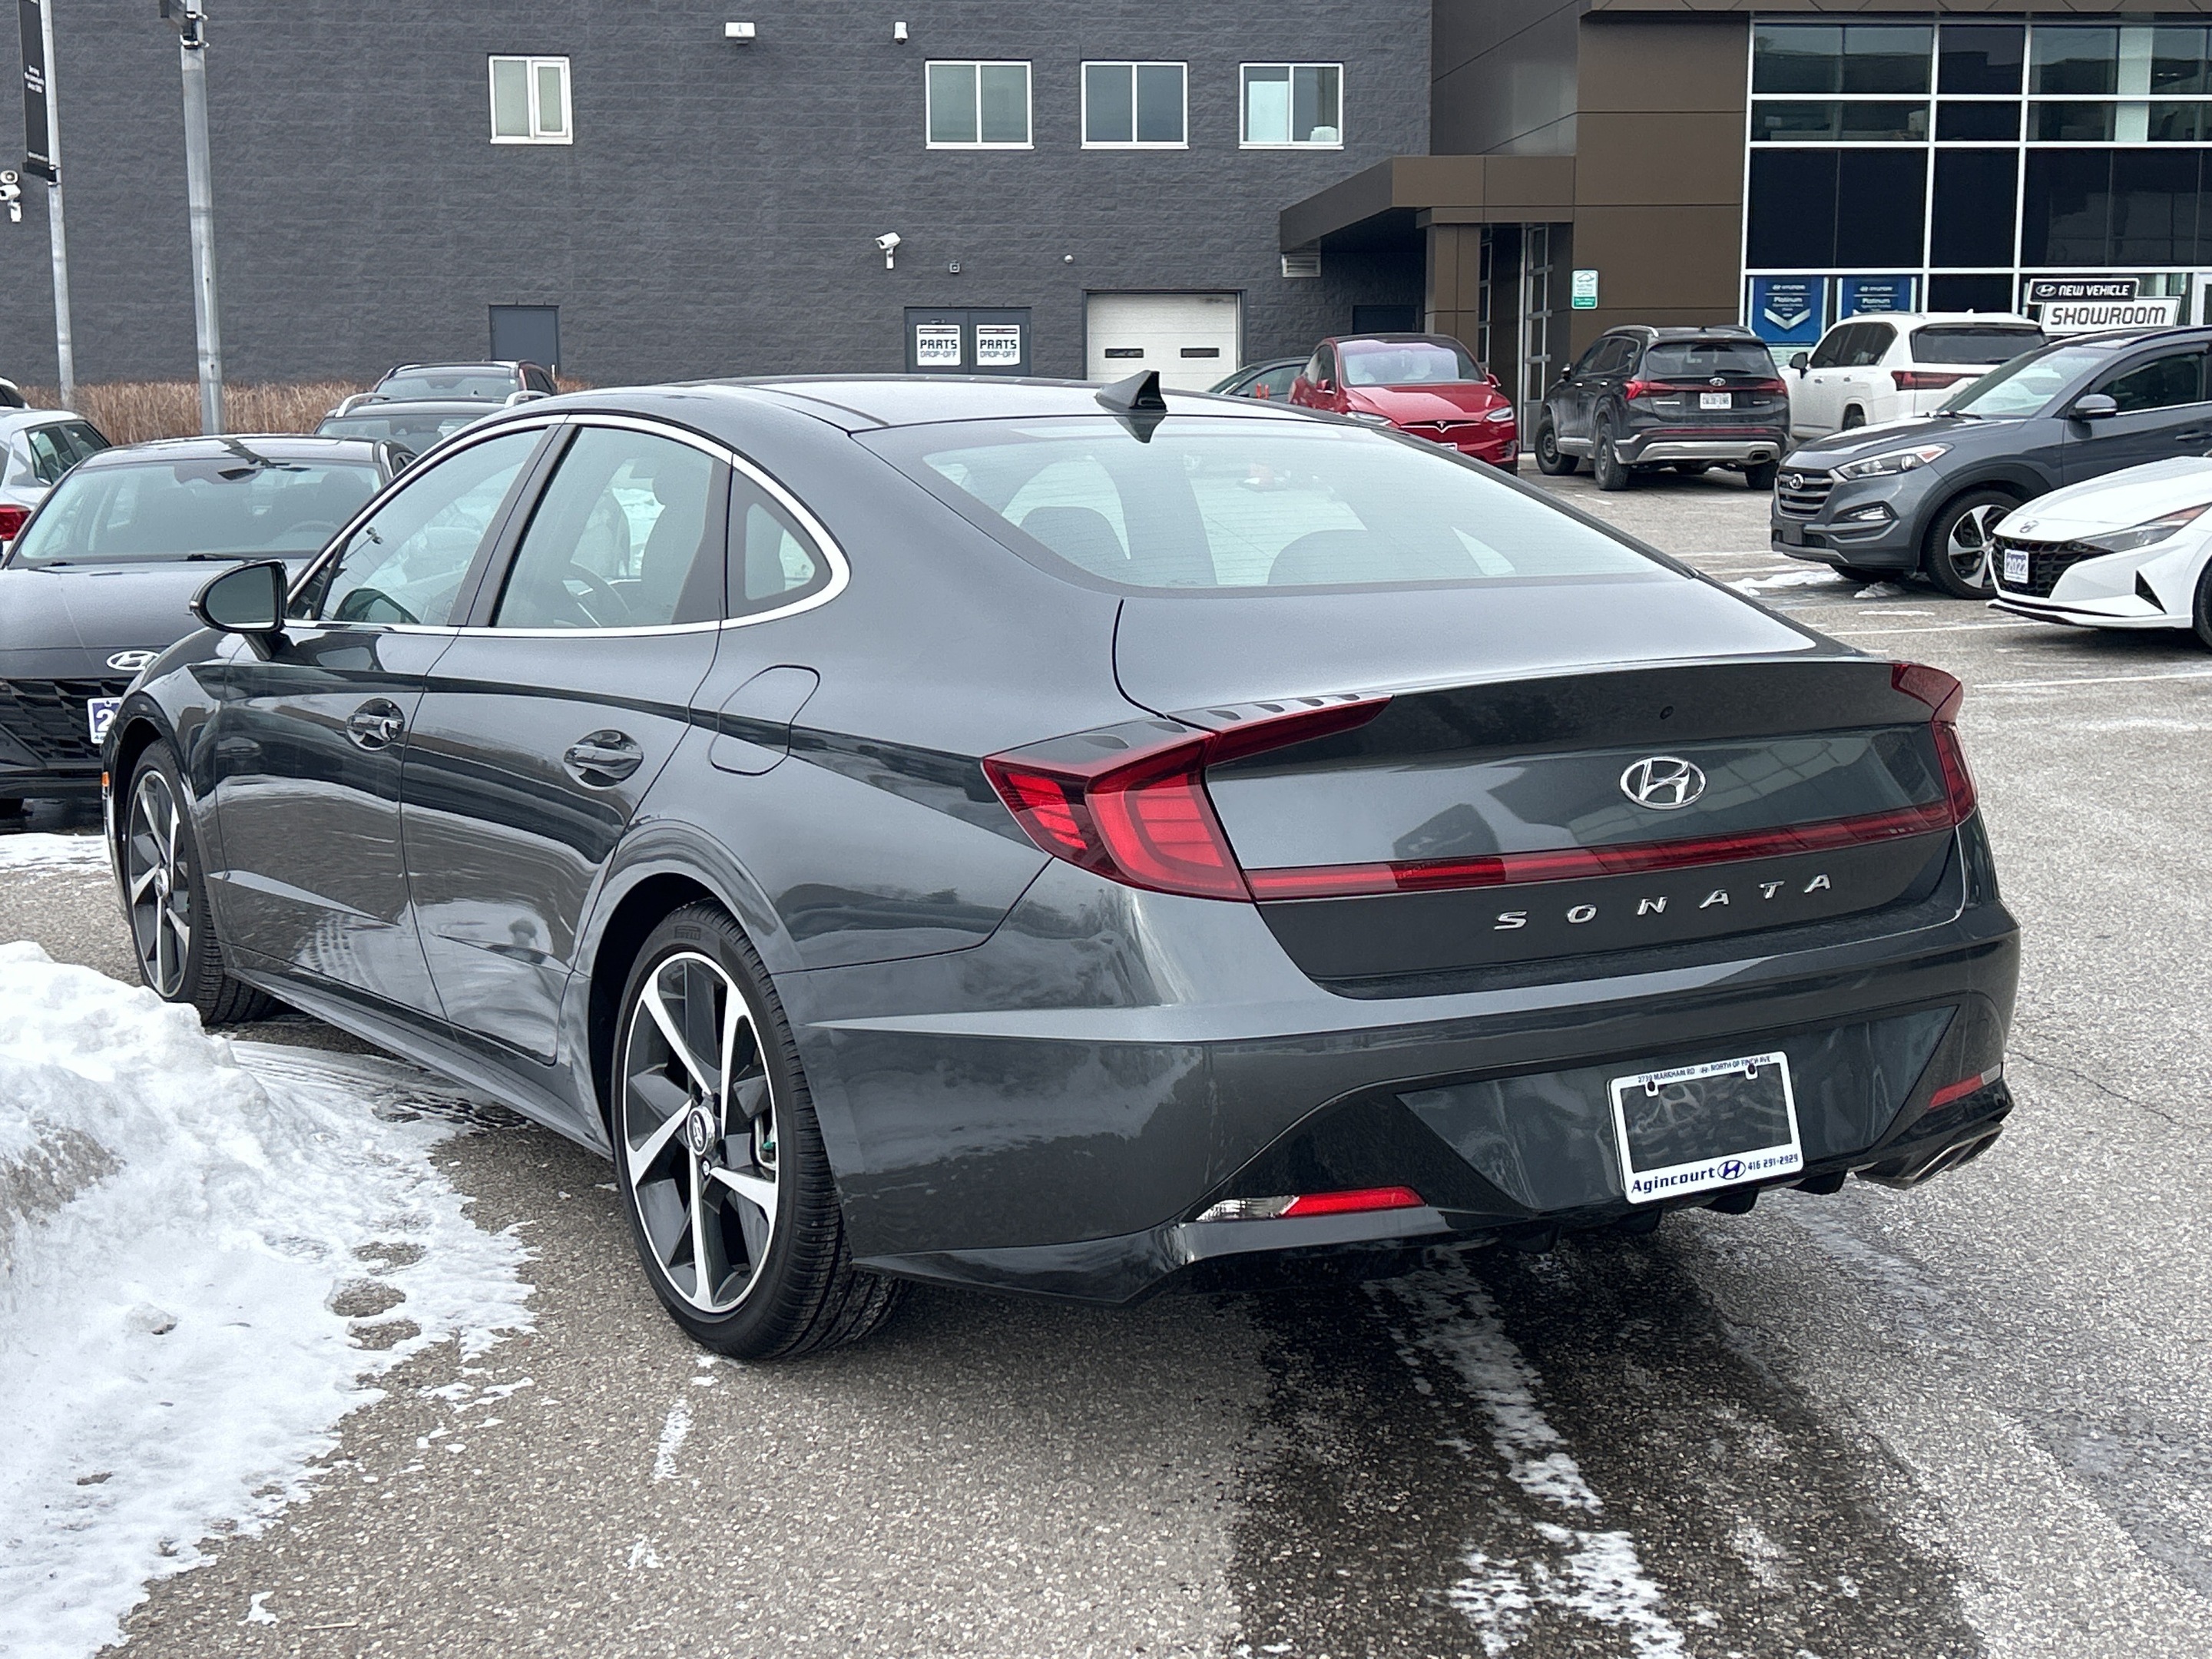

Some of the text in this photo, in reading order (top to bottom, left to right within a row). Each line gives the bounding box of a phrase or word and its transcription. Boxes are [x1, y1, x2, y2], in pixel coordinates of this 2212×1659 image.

[2058, 284, 2130, 296] NEW VEHICLE
[2050, 306, 2167, 326] SHOWROOM
[919, 339, 957, 349] PARTS
[979, 339, 1017, 349] PARTS
[2006, 557, 2027, 575] 2022
[1494, 873, 1831, 930] SONATA
[1654, 1068, 1687, 1080] MARKHAM
[1687, 1067, 1695, 1075] RD
[1710, 1061, 1732, 1071] NORTH
[1631, 1167, 1716, 1194] Agincourt
[1748, 1160, 1761, 1170] 416
